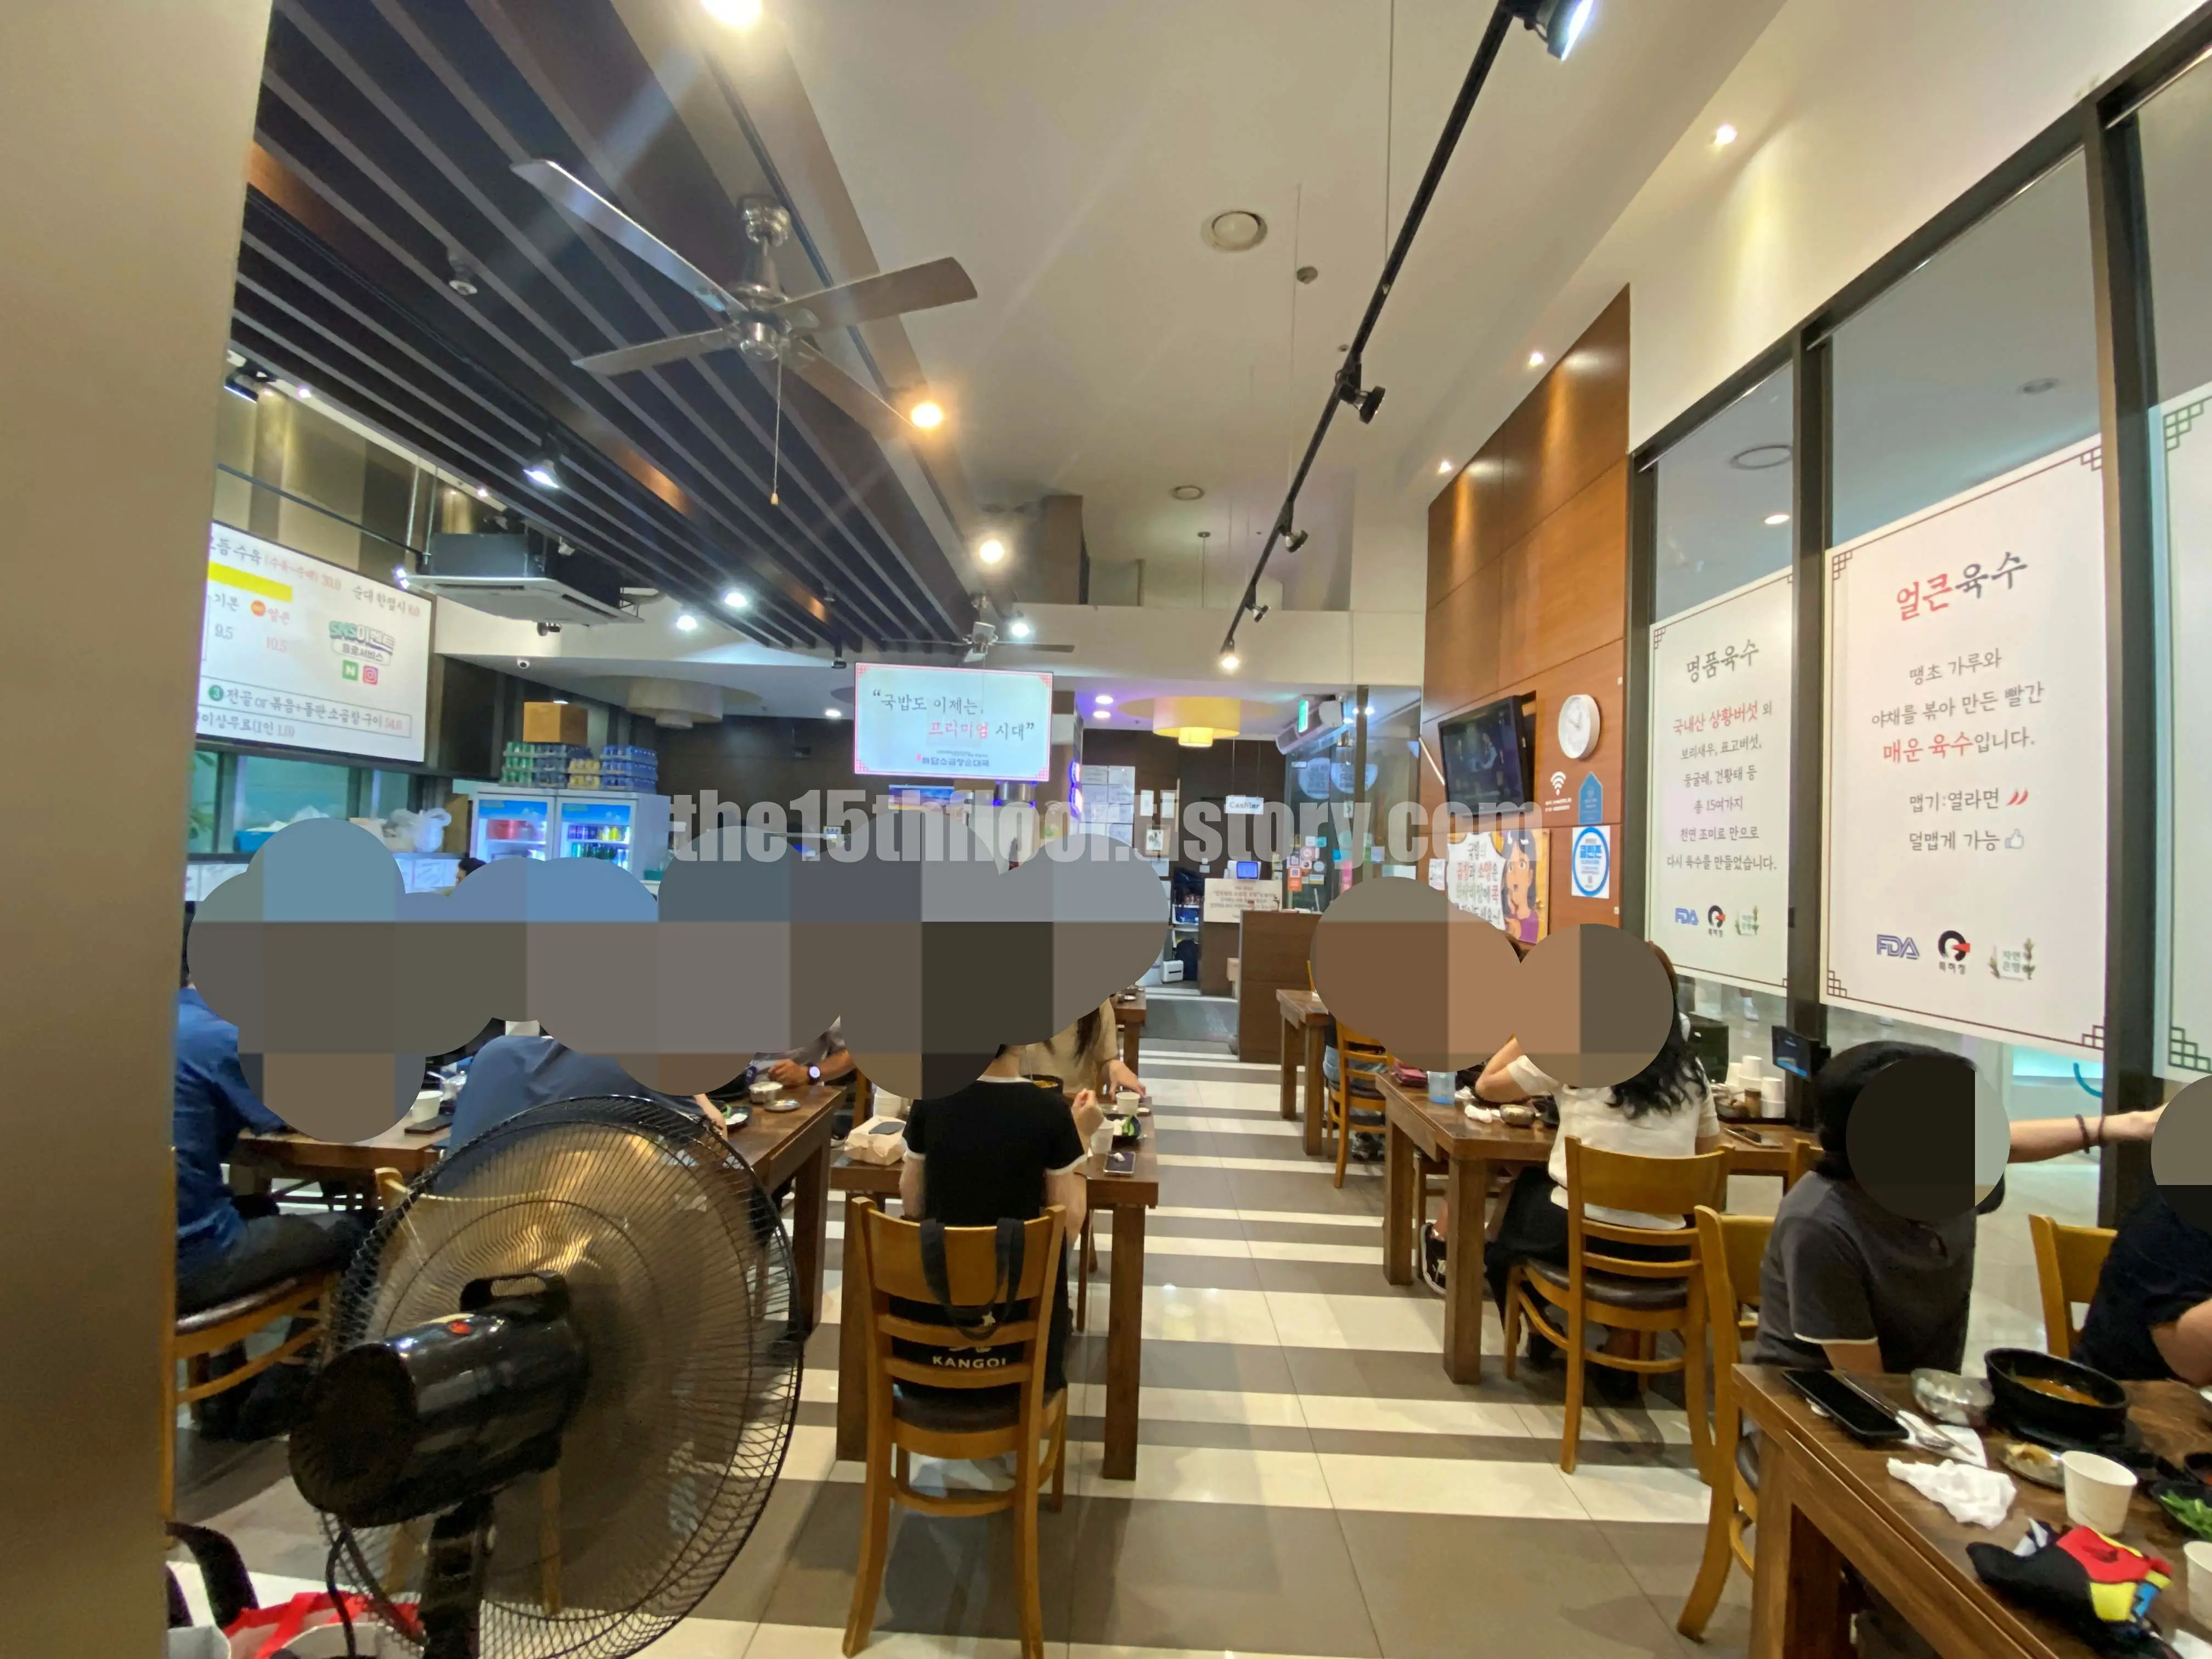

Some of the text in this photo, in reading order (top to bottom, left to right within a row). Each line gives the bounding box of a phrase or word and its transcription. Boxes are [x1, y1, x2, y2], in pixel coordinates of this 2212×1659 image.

[233, 546, 262, 566] 수육
[352, 585, 373, 603] 순대
[1897, 551, 2028, 621] 얼큰육수
[215, 594, 240, 612] 기본
[1686, 639, 1759, 683] 명품육수
[1909, 647, 2002, 686] 땡초 가루와
[226, 688, 252, 707] 전골
[1872, 681, 2045, 728] 야채를 볶아 만든 빨간
[1673, 700, 1772, 736] 국내산 상황버섯 외
[929, 720, 1035, 741] 프리미엄 시대”
[1681, 733, 1762, 759] 보리새우, 표고버섯,
[1883, 726, 2035, 764] 매운 육수입니다.
[1715, 766, 1742, 783] 건황태
[1747, 765, 1757, 780] 등
[1229, 801, 1260, 809] Cashier
[1694, 795, 1743, 814] 총 15여가지
[1680, 826, 1759, 842] 천연 조미료 만으로
[1909, 830, 2001, 851] 덜맵게 가능
[1667, 855, 1777, 871] 다시 육수를 만들었습니다.
[1675, 908, 1699, 926] FDA
[1876, 934, 1920, 960] FDA
